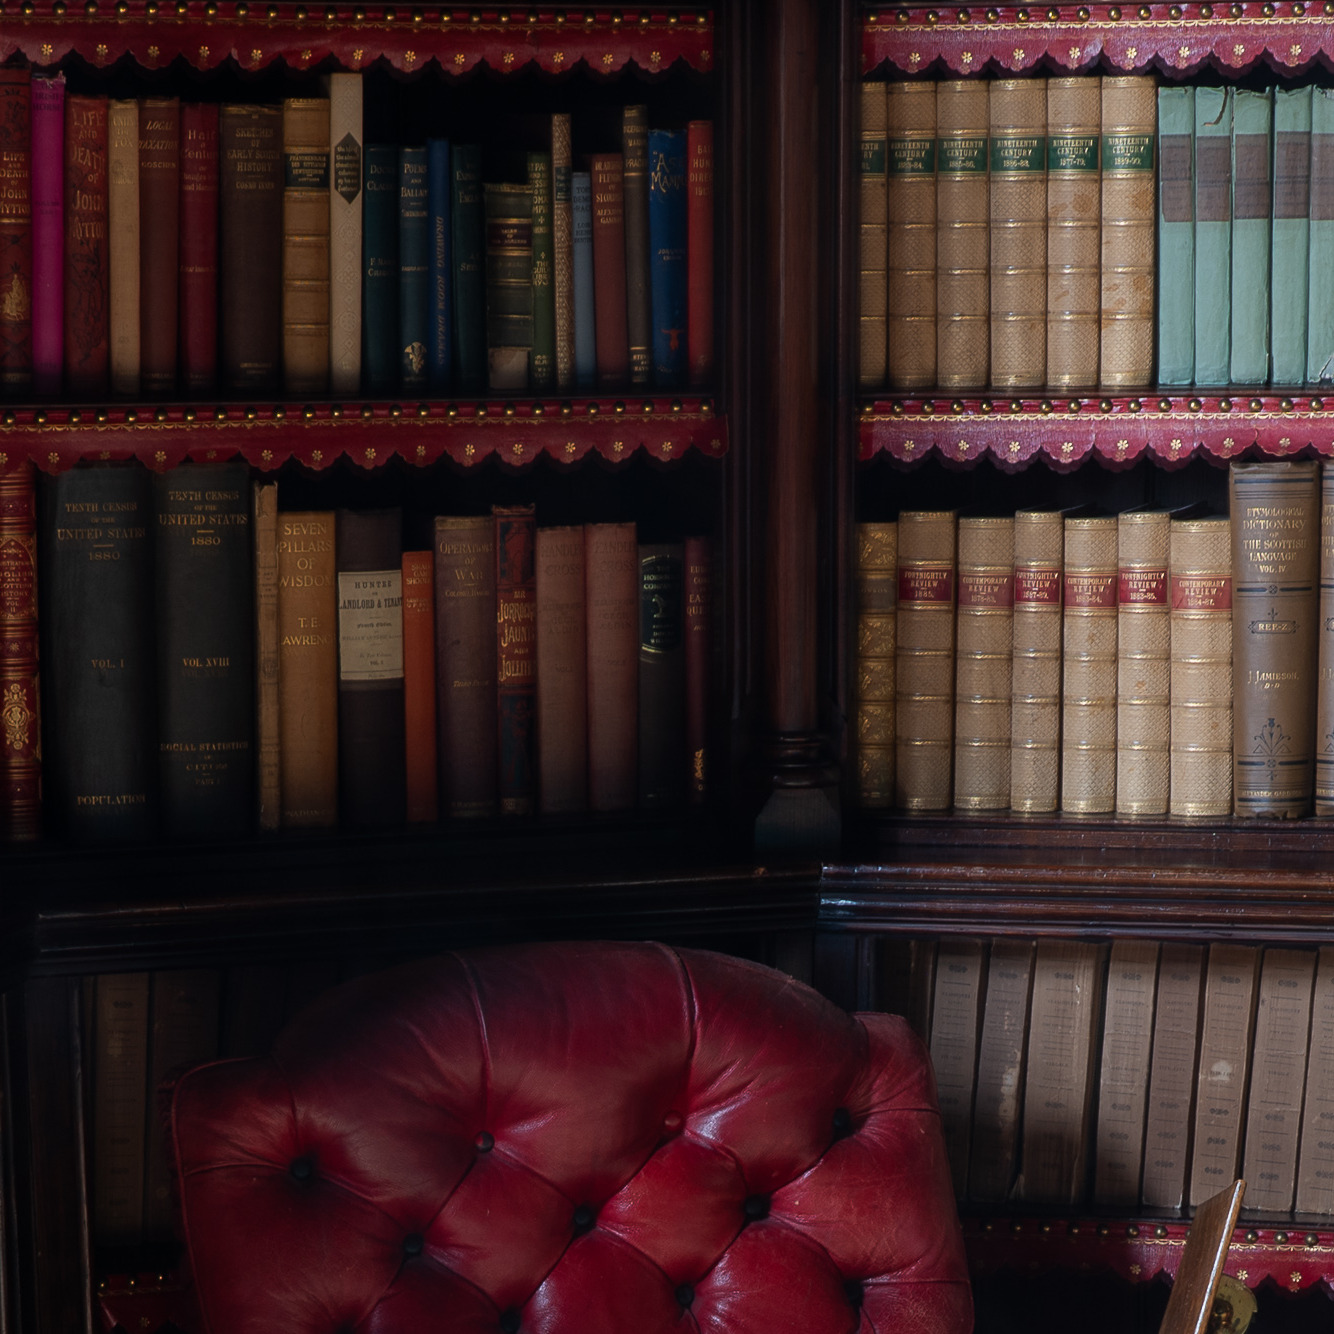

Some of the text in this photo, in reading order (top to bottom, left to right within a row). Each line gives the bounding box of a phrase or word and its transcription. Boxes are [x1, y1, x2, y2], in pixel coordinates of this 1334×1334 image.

[74, 109, 104, 127] LIFE
[145, 120, 173, 131] LOCAL
[3, 152, 25, 162] LIFE
[0, 186, 27, 199] JOHN
[436, 216, 446, 268] DRAWING
[436, 275, 446, 301] ROOM
[169, 491, 239, 501] TENTH CENSUS
[66, 502, 137, 513] TENTH CENSUS
[158, 513, 247, 525] UNITED STATES
[57, 527, 146, 540] UNITED STATES
[284, 522, 327, 536] SEVEN
[191, 536, 221, 545] 1880
[279, 540, 332, 553] PILLARS
[88, 551, 121, 561] 1880
[297, 558, 316, 570] OF
[454, 569, 483, 581] WAR
[91, 659, 116, 669] VOL.
[77, 794, 145, 806] POPULATION
